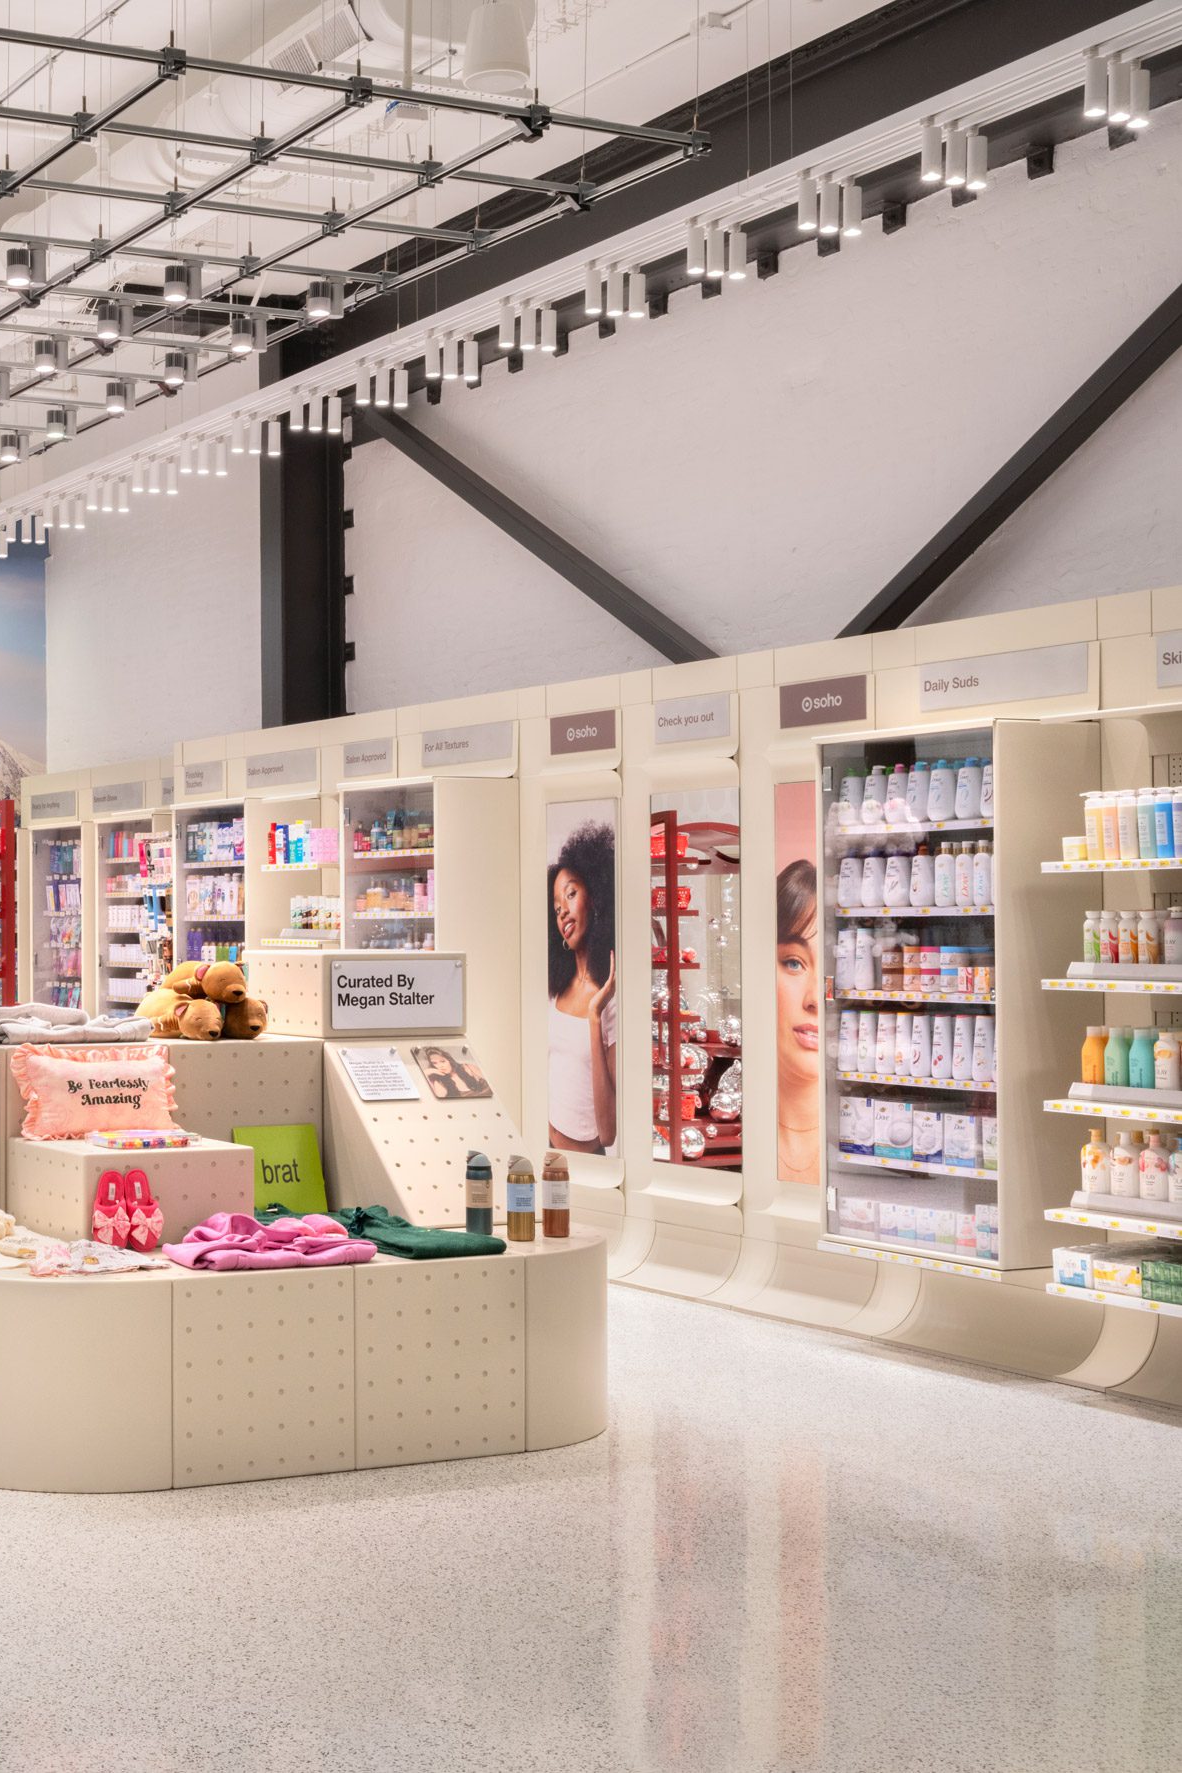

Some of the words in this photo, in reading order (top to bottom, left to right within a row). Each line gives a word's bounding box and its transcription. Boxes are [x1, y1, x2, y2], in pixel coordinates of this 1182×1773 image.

[1162, 651, 1182, 666] Ski
[923, 679, 950, 693] Daily
[952, 675, 979, 689] Suds
[812, 692, 843, 709] soho
[657, 714, 683, 728] Check
[683, 714, 699, 728] you
[699, 711, 714, 723] out
[575, 725, 598, 739] soho
[424, 743, 434, 753] For
[435, 742, 443, 751] All
[444, 740, 469, 750] Textures
[346, 754, 361, 764] Salon
[361, 751, 387, 763] Approved
[261, 765, 284, 776] Approved
[336, 974, 393, 989] Curated
[397, 974, 415, 990] By
[337, 992, 385, 1010] Megan
[389, 991, 435, 1006] Stalter
[67, 1080, 83, 1094] Be
[89, 1077, 150, 1092] Fearlessly
[81, 1093, 143, 1110] Amazing
[261, 1158, 300, 1185] brat
